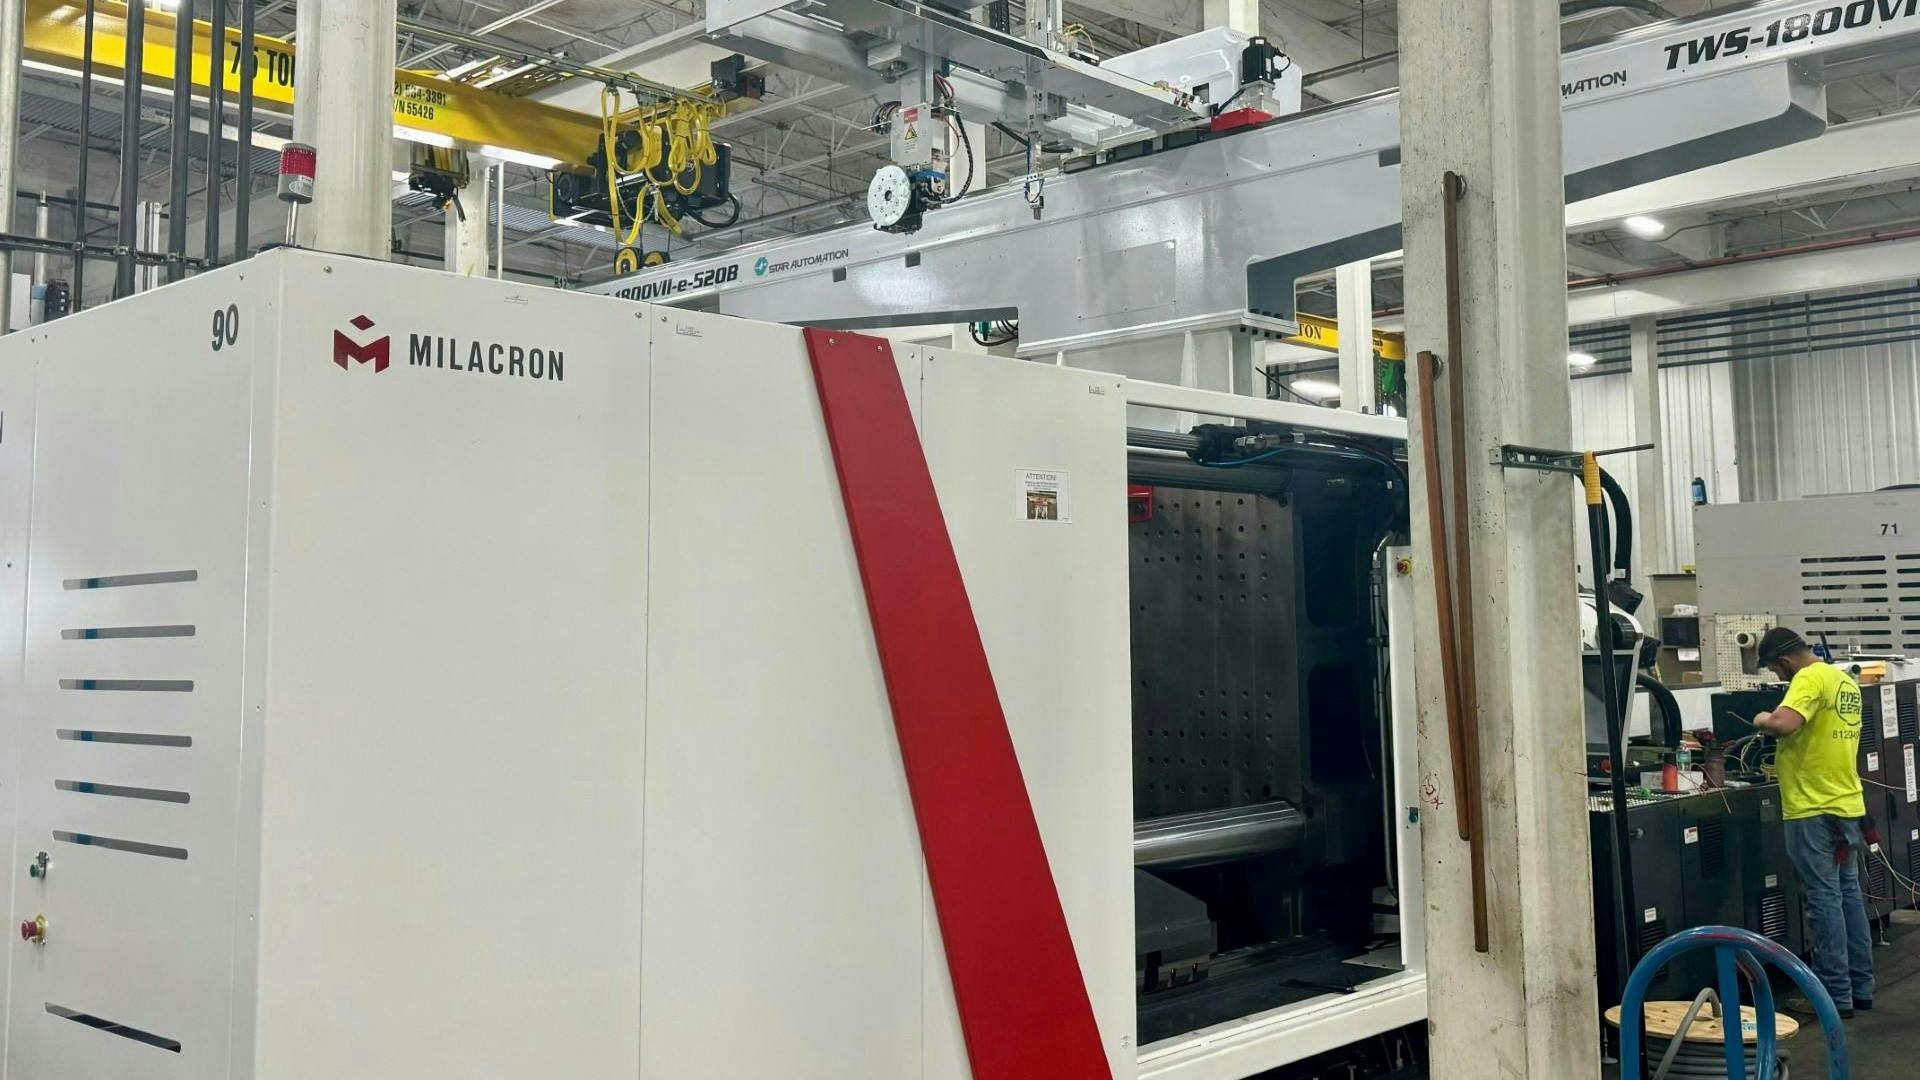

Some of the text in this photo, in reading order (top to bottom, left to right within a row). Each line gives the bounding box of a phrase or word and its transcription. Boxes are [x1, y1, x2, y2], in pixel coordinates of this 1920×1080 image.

[406, 102, 434, 120] 55426
[768, 248, 849, 274] STAR AUTOMATION
[211, 303, 239, 352] 90
[409, 333, 564, 381] MILACRON
[1880, 523, 1898, 536] 71
